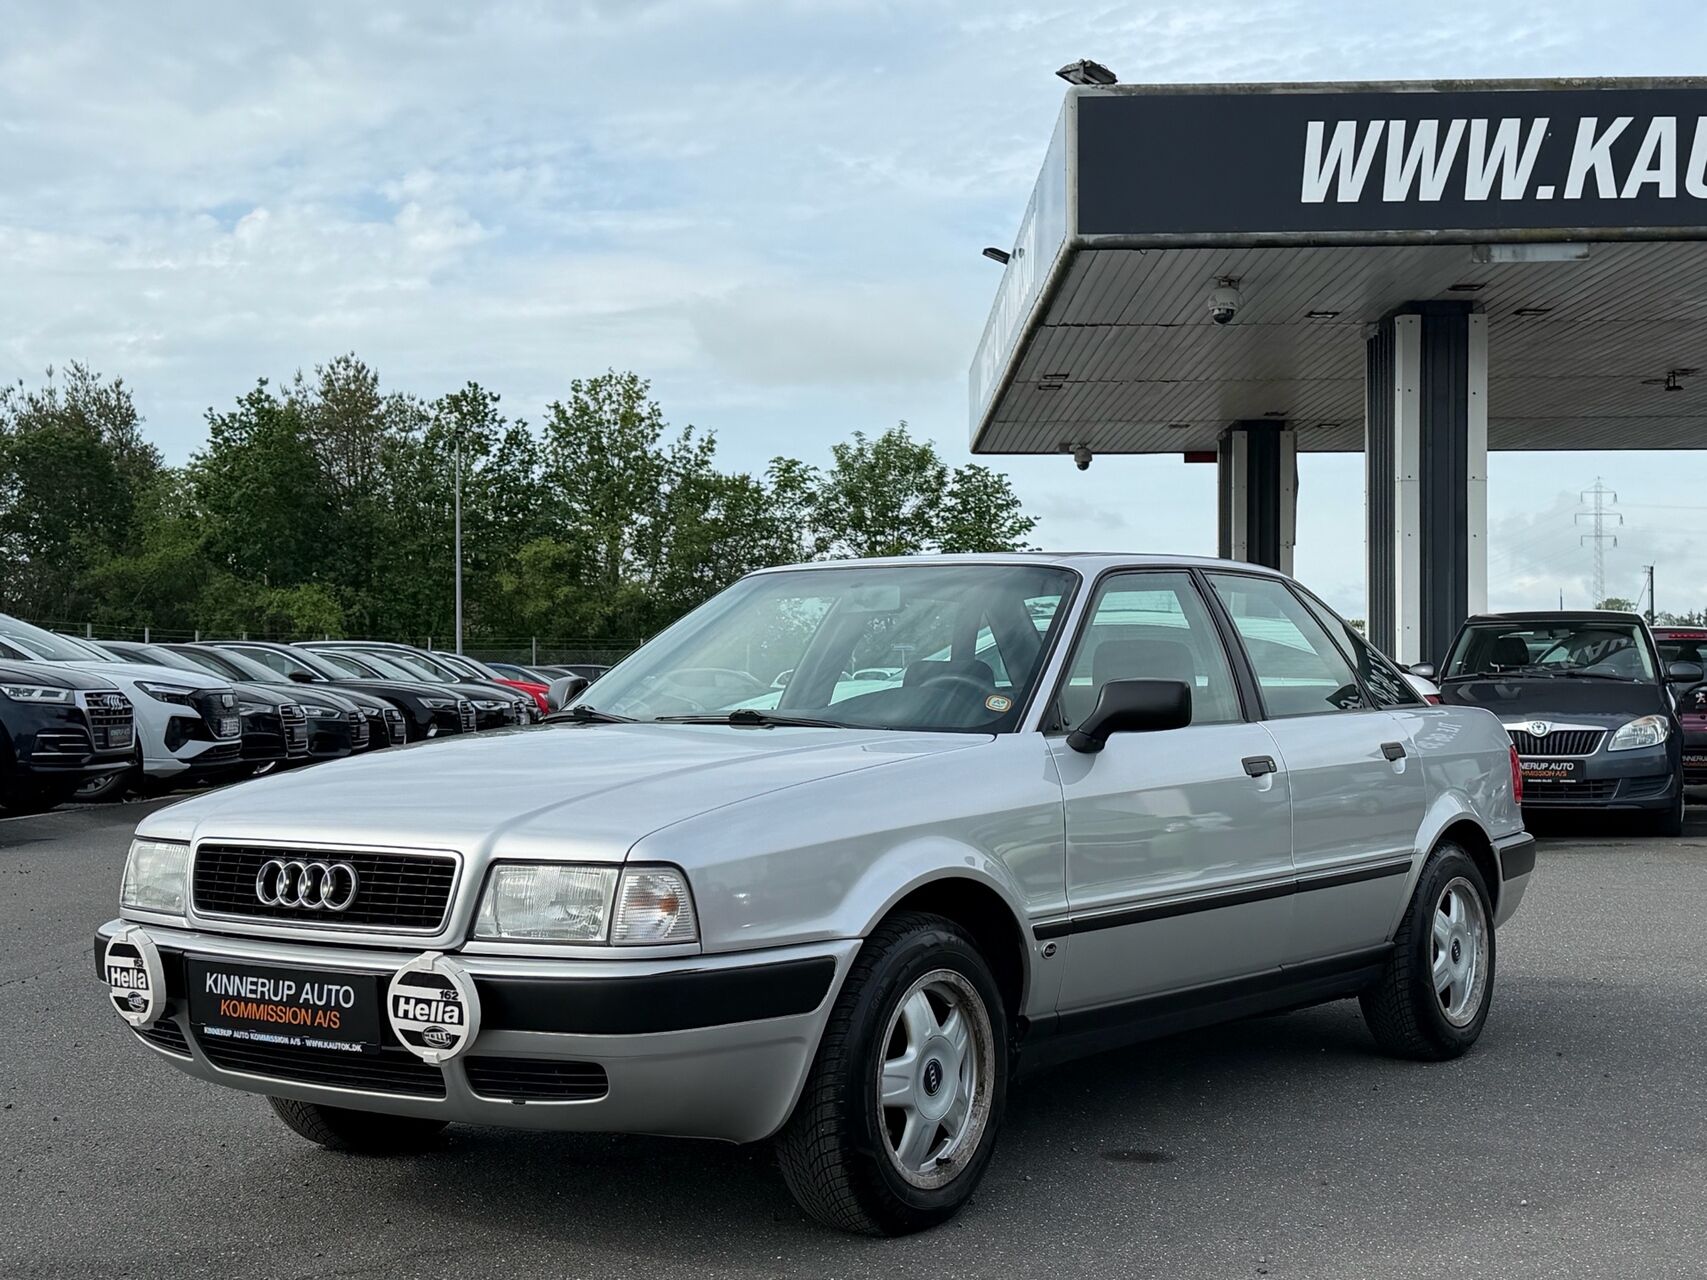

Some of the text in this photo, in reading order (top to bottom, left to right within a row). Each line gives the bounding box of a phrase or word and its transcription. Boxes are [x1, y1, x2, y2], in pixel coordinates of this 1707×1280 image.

[1520, 762, 1574, 771] NERUP AUTO
[110, 966, 147, 989] Hella
[205, 972, 355, 1009] KINNERUP AUTO
[439, 989, 459, 1001] 162
[220, 999, 340, 1029] KOMMISSION A/S
[397, 996, 460, 1024] Hella
[233, 1030, 250, 1040] AUTO
[290, 1037, 301, 1046] A/S
